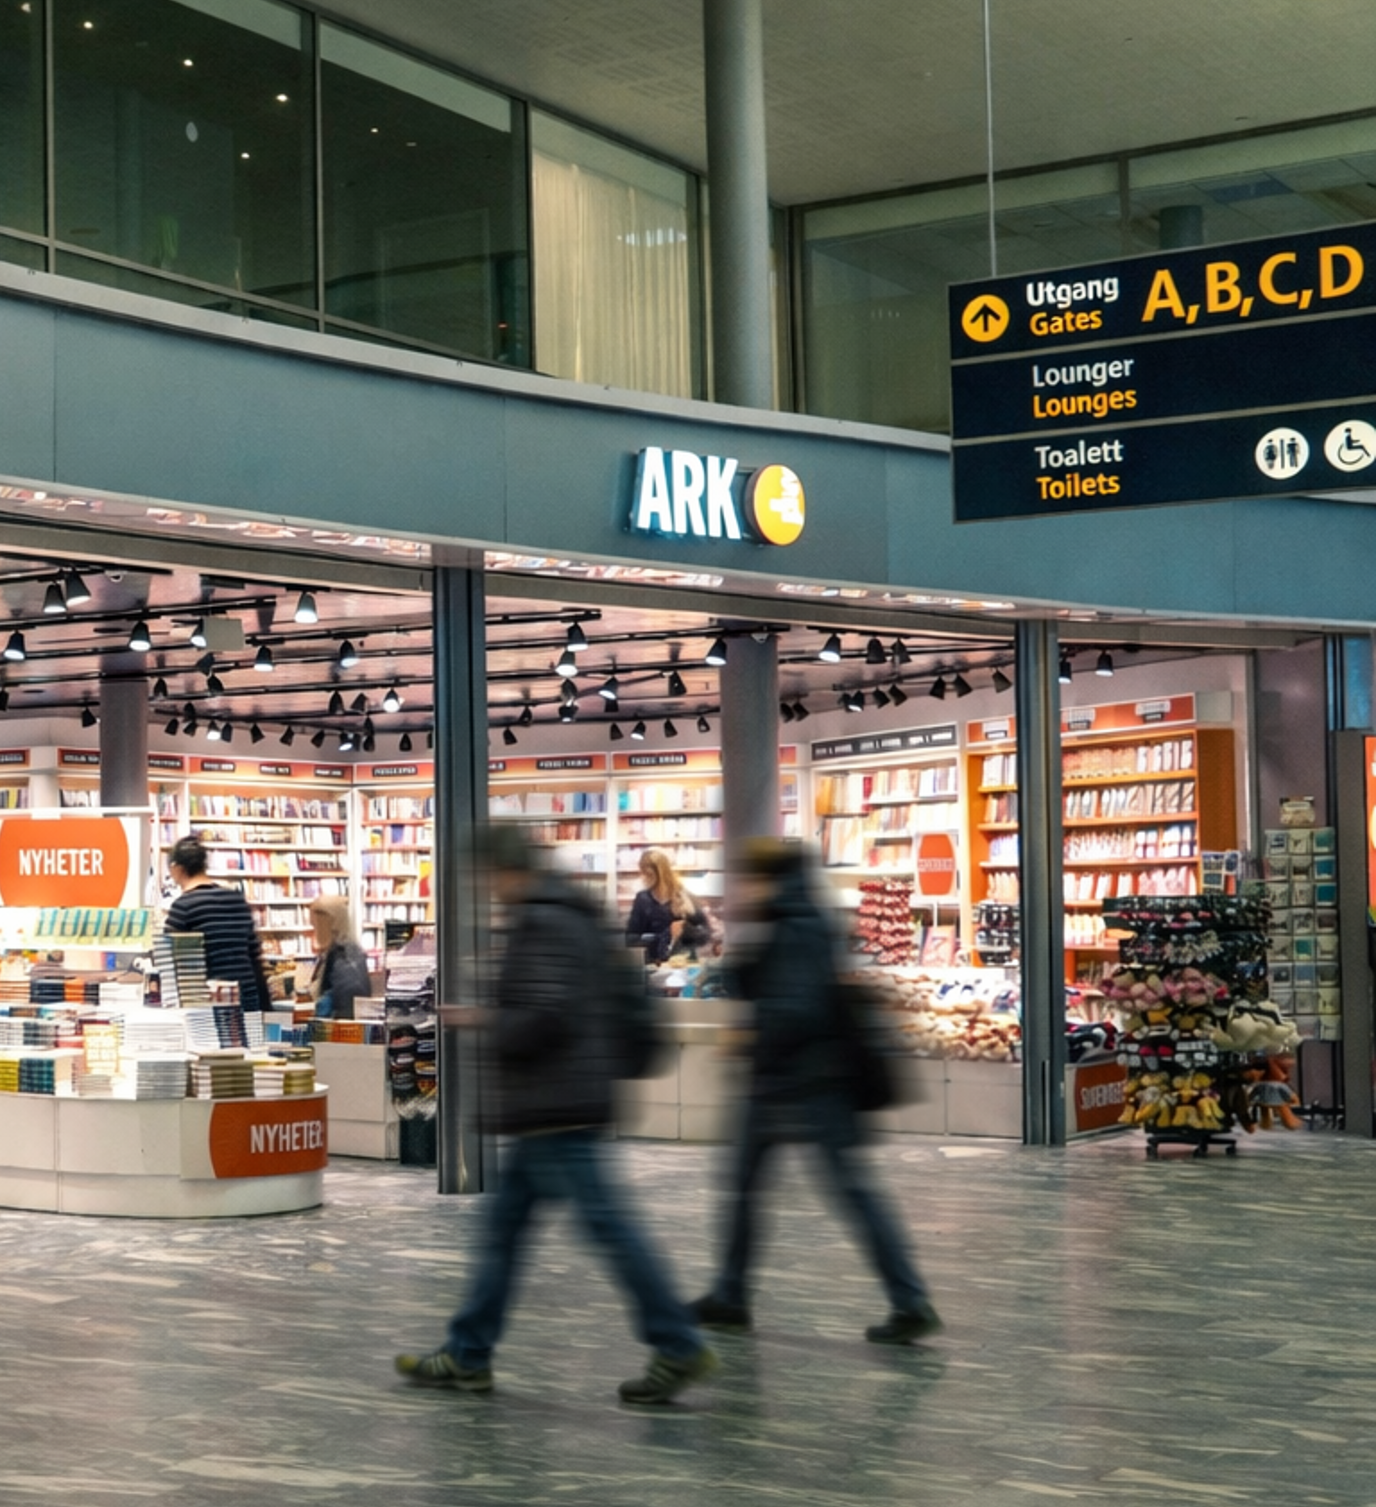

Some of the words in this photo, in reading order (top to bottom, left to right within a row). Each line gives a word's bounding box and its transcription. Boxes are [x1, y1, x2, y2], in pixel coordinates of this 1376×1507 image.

[1026, 277, 1119, 308] Utgang
[1141, 245, 1364, 324] A,B,C,D
[1029, 310, 1102, 336] Gates
[1032, 359, 1135, 388] Lounger
[1033, 389, 1137, 419] Lounges
[1034, 439, 1124, 469] Toalett
[636, 446, 741, 539] ARK
[1036, 473, 1121, 500] Toilets
[18, 848, 104, 876] NYHETER
